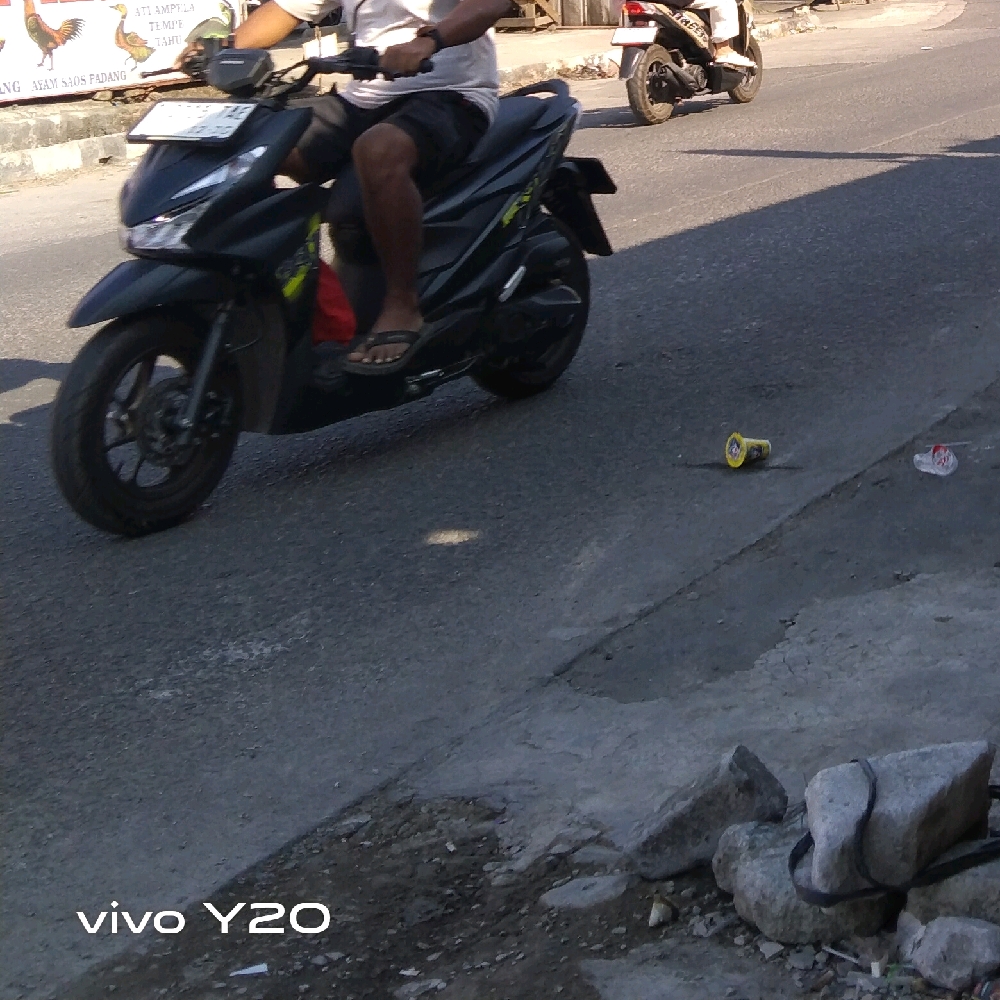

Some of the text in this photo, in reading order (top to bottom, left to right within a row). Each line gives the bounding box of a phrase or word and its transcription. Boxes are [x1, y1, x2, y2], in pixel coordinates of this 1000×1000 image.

[135, 3, 195, 17] ATI AMPELA
[149, 19, 184, 32] TEMPE
[155, 34, 181, 47] TAHU
[31, 77, 58, 92] AYAM
[62, 74, 87, 88] SAOS
[89, 70, 127, 85] PADANG
